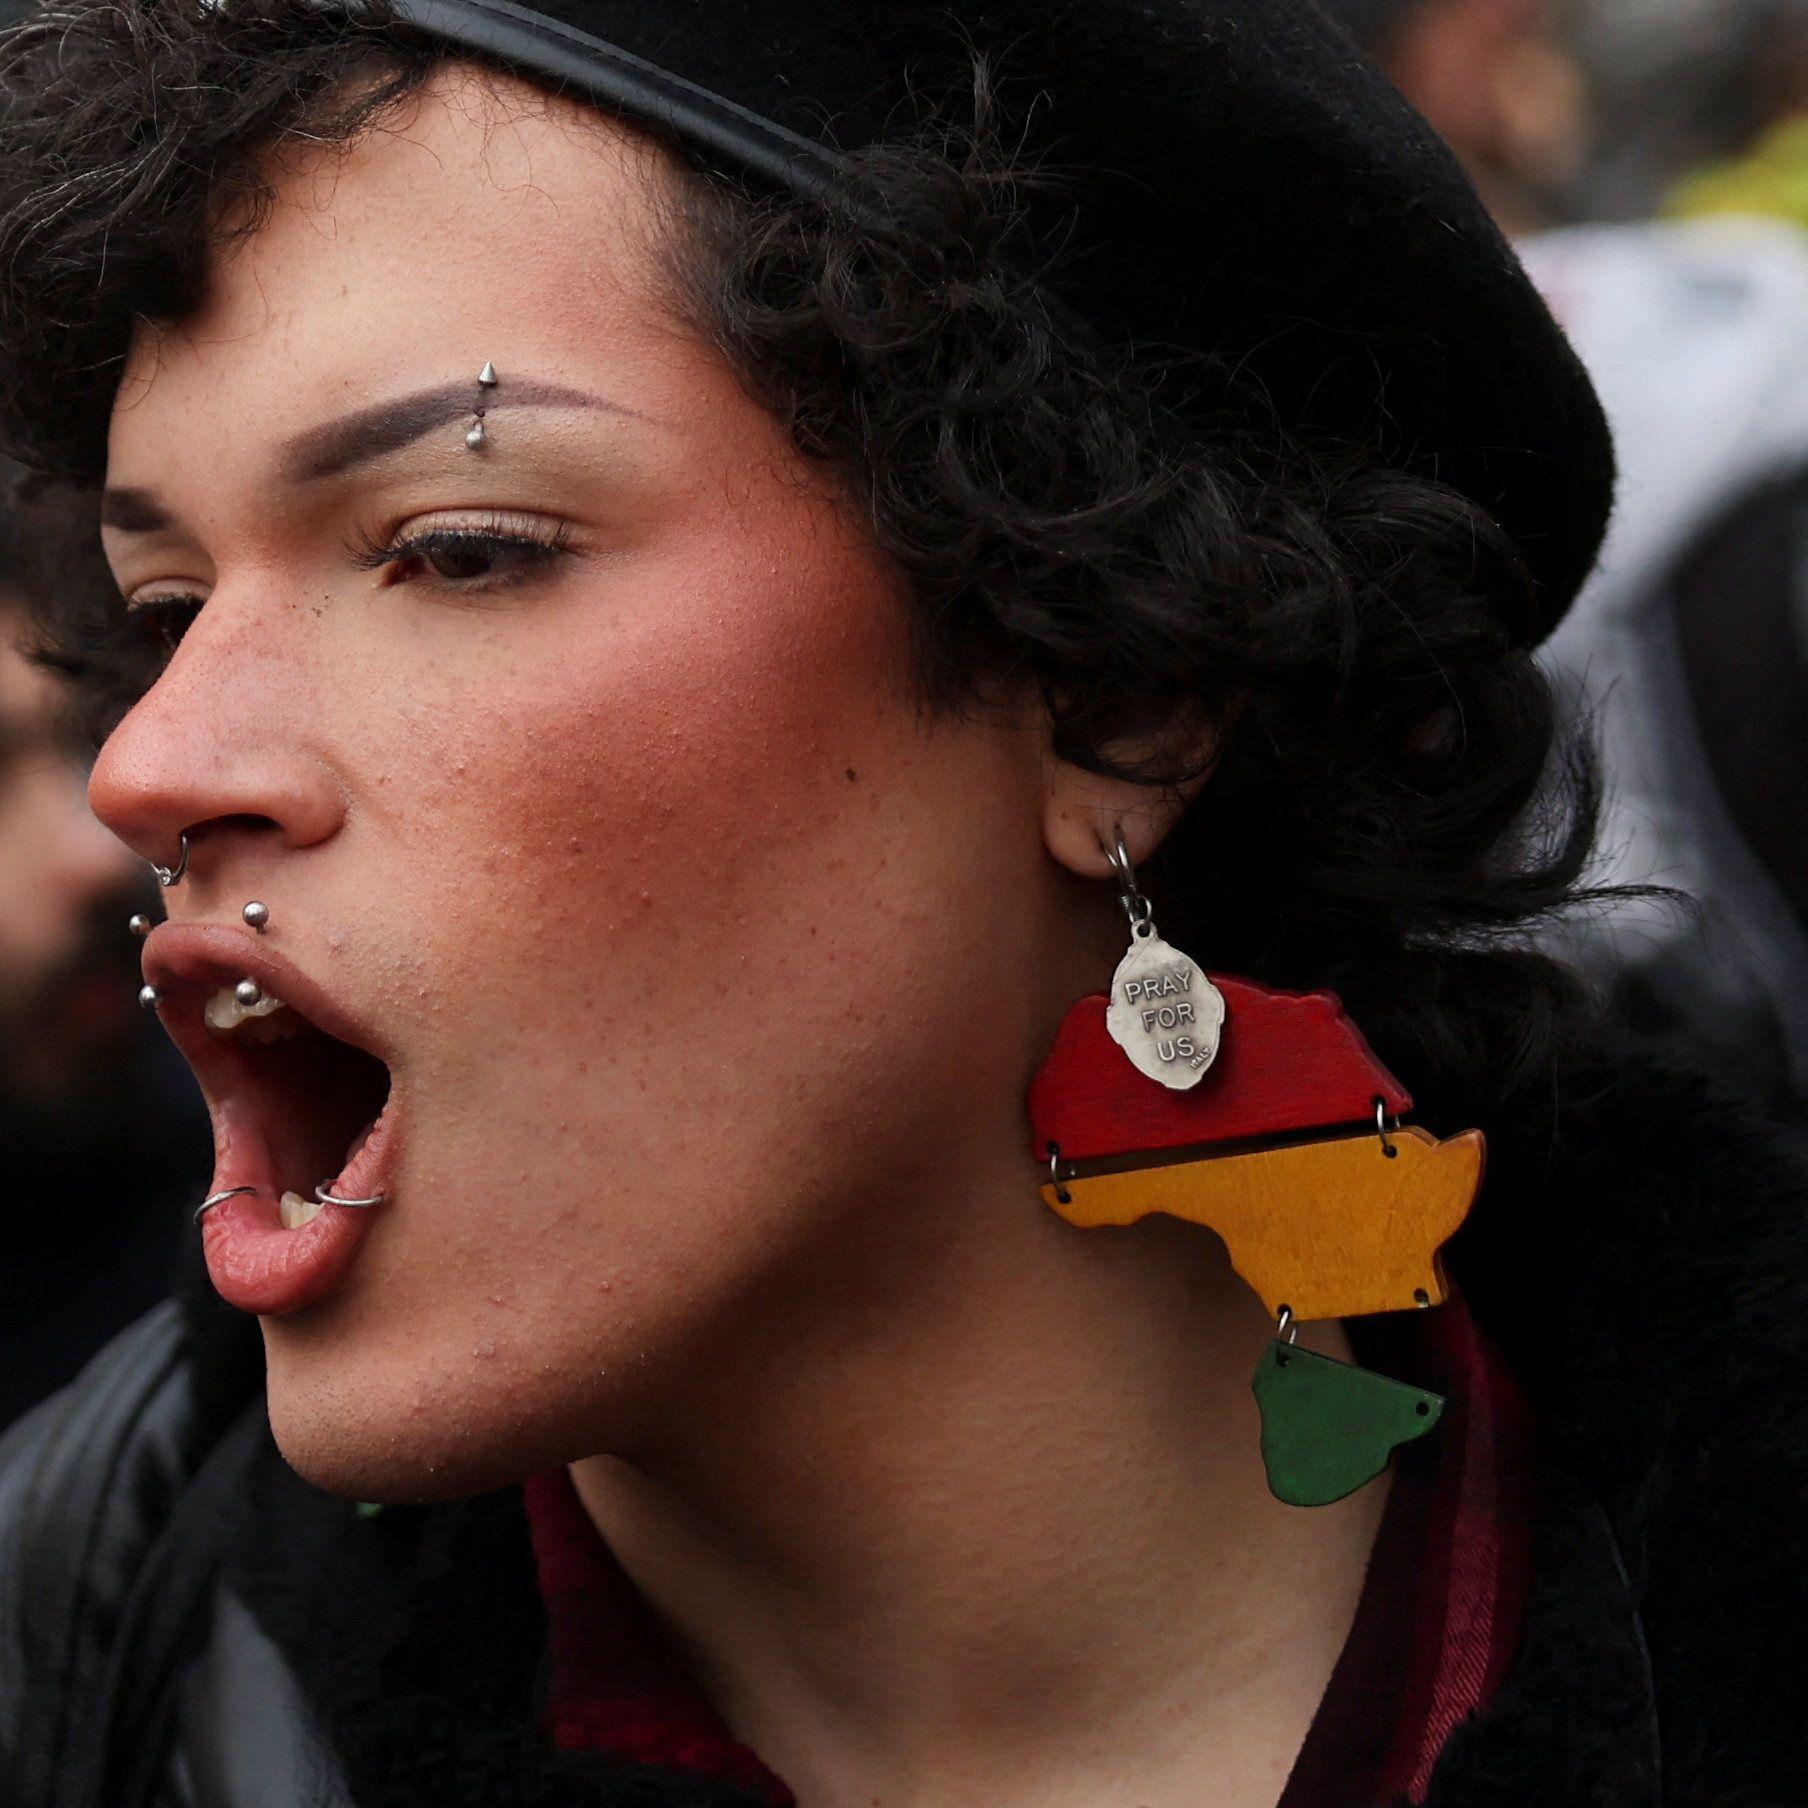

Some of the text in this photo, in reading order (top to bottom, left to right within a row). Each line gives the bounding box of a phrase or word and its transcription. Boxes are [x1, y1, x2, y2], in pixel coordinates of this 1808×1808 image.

[1125, 971, 1192, 1005] PRAY
[1142, 1003, 1195, 1033] FOR
[1157, 1037, 1195, 1062] US
[1190, 1047, 1212, 1069] ITALY
